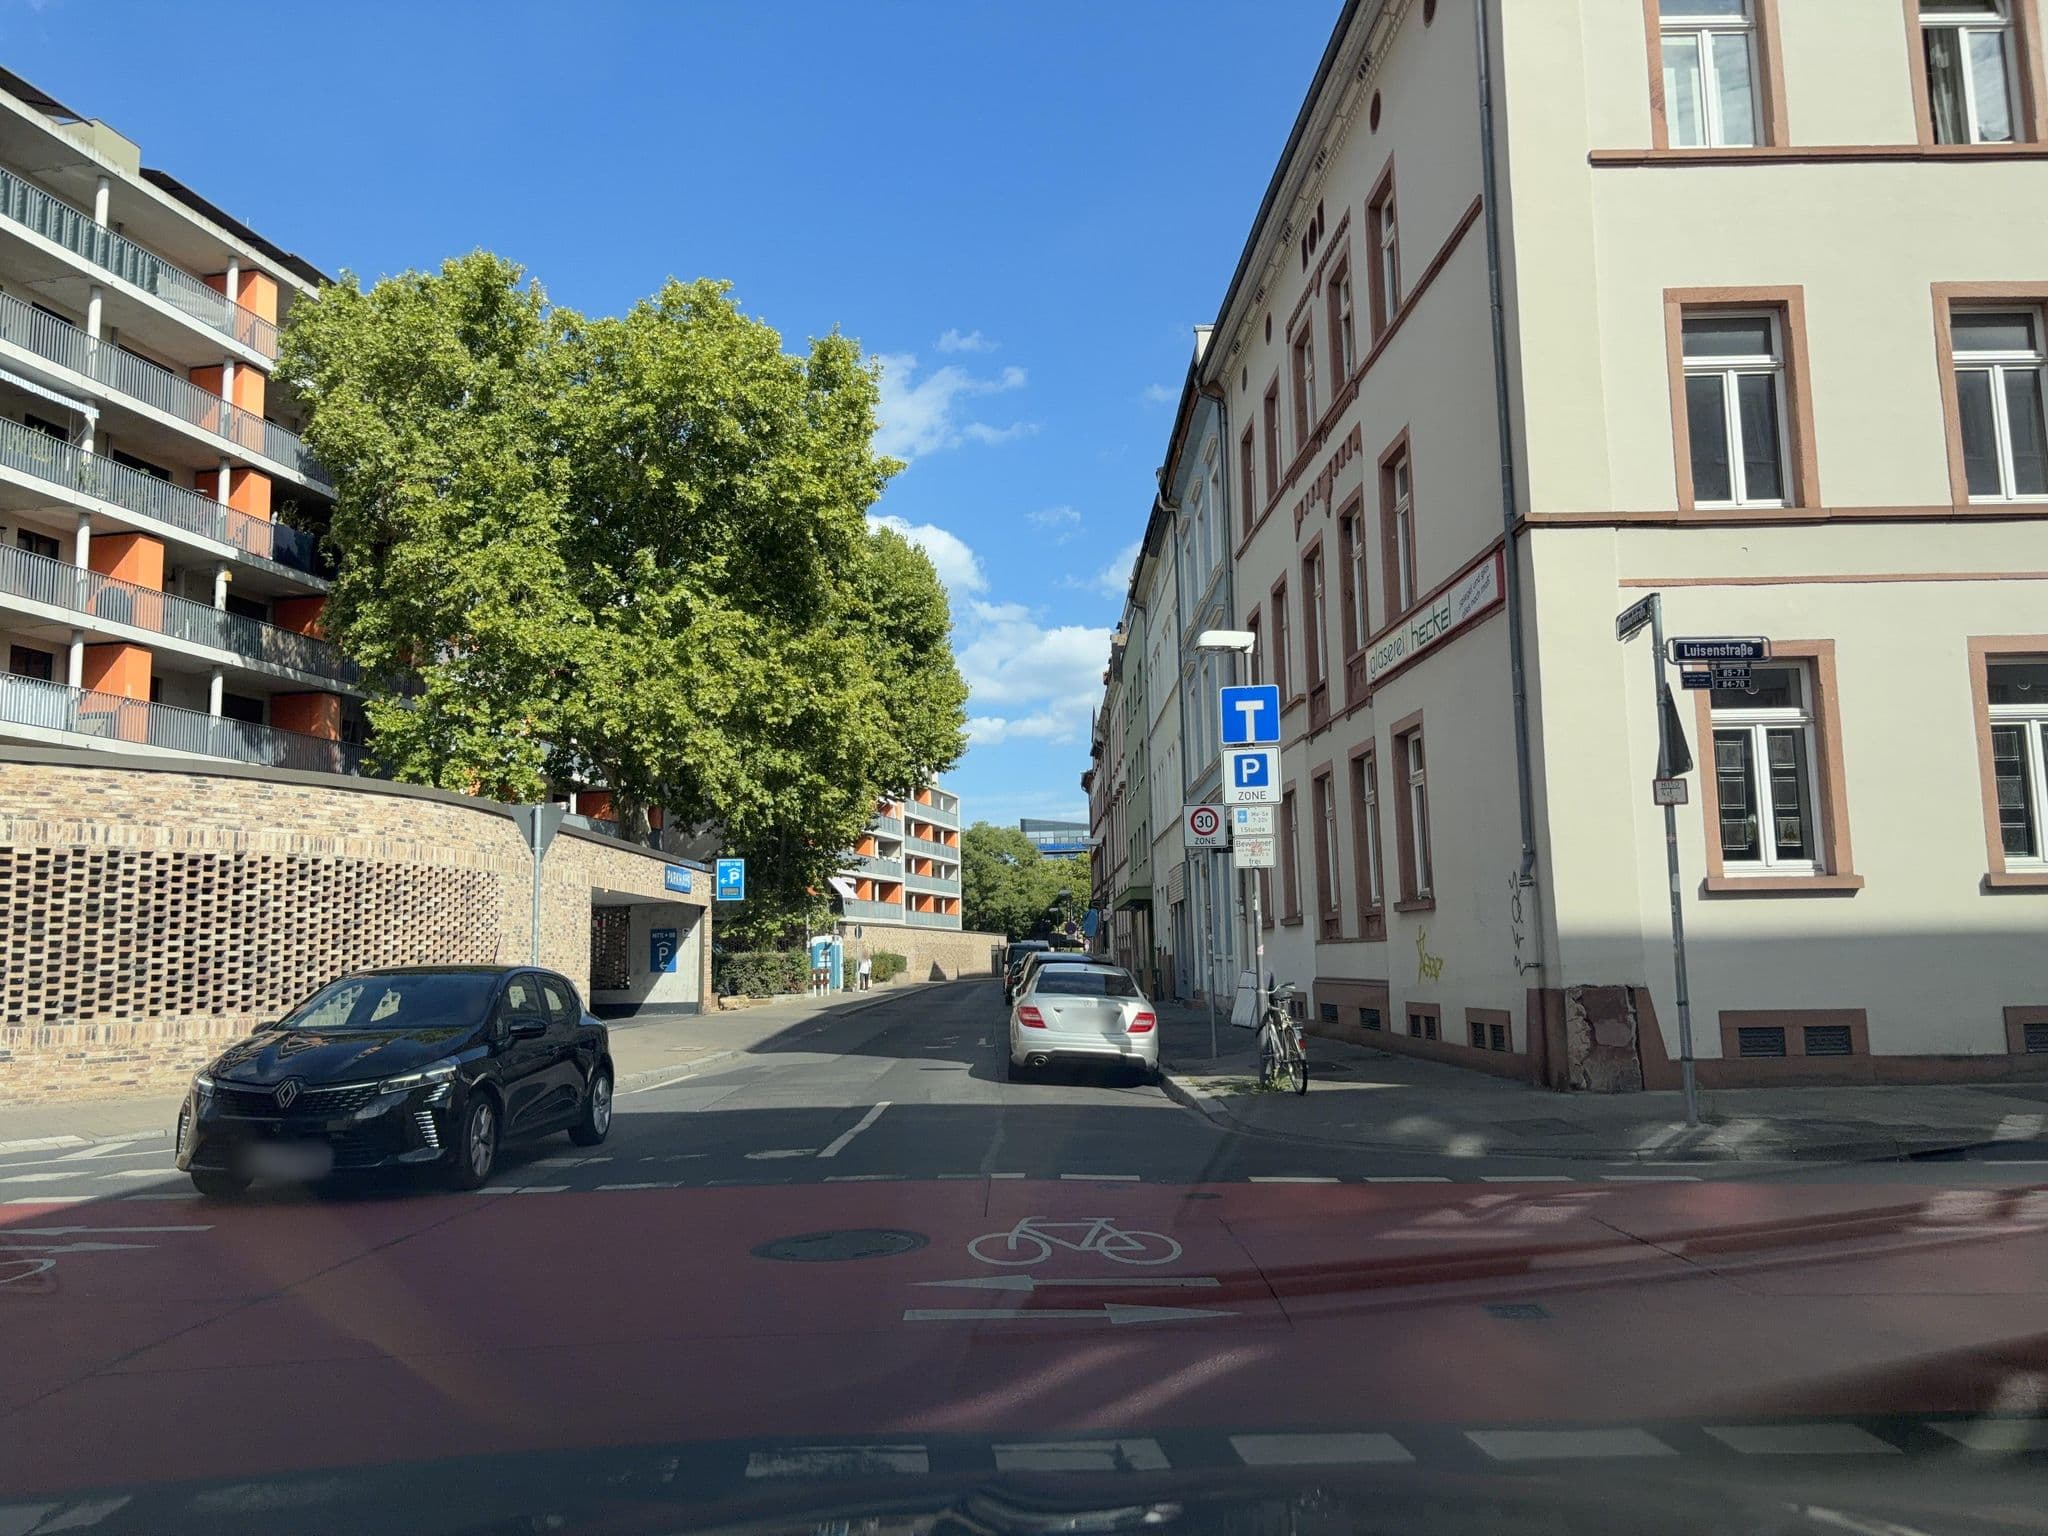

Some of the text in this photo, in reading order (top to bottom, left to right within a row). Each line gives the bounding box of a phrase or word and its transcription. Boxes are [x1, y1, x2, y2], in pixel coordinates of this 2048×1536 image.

[1369, 631, 1406, 680] glaserei
[1683, 643, 1754, 658] Luisenstraße
[1241, 758, 1260, 783] P
[1238, 791, 1267, 800] ZONE
[1196, 815, 1213, 828] 30
[1194, 837, 1217, 845] ZONE
